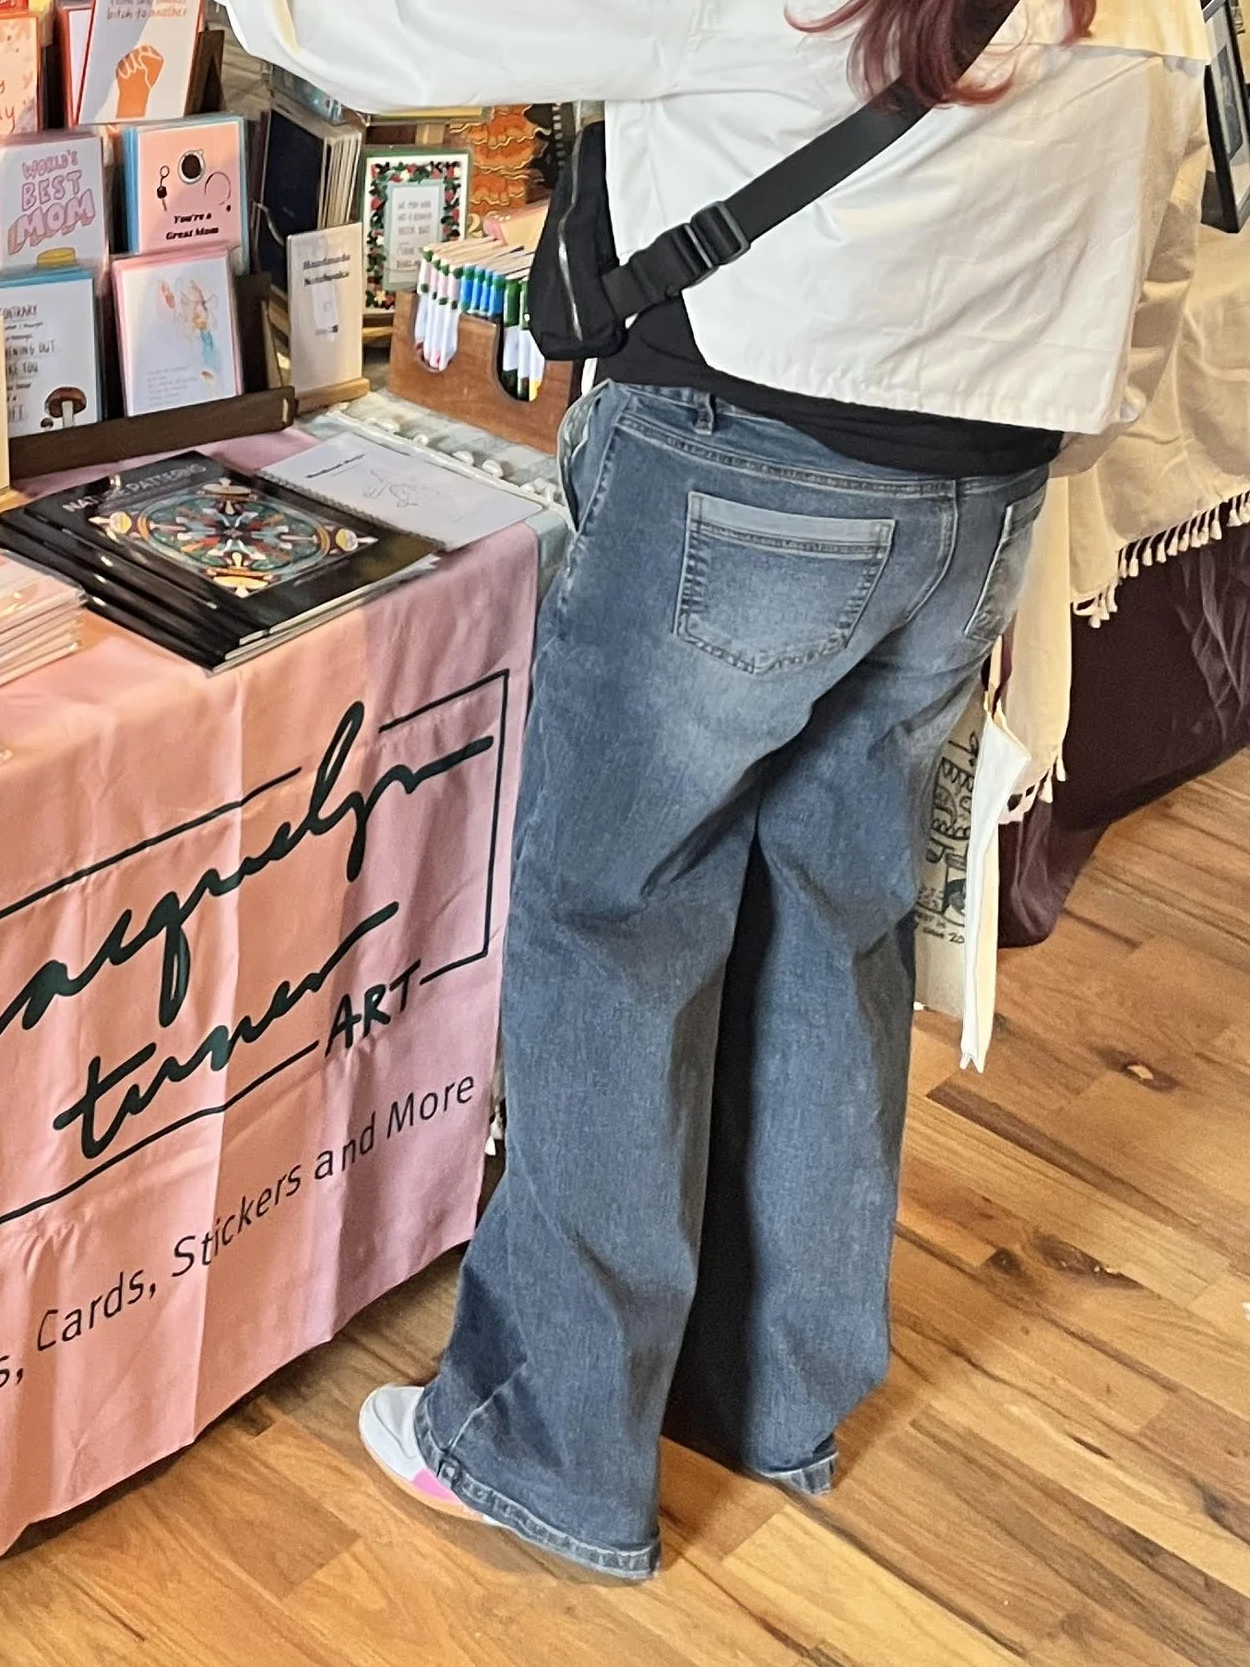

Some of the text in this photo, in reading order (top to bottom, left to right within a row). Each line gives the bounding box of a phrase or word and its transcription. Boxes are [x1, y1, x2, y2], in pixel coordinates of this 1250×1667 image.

[21, 149, 79, 180] WORLD'S
[21, 169, 82, 212] BEST
[7, 188, 96, 256] MOM
[165, 227, 219, 240] Great Mom
[174, 213, 205, 224] You're
[326, 961, 422, 1060] ART
[34, 1272, 158, 1352] Cards,
[171, 1163, 303, 1278] Stickers
[313, 1107, 376, 1179] and
[386, 1071, 476, 1142] More
